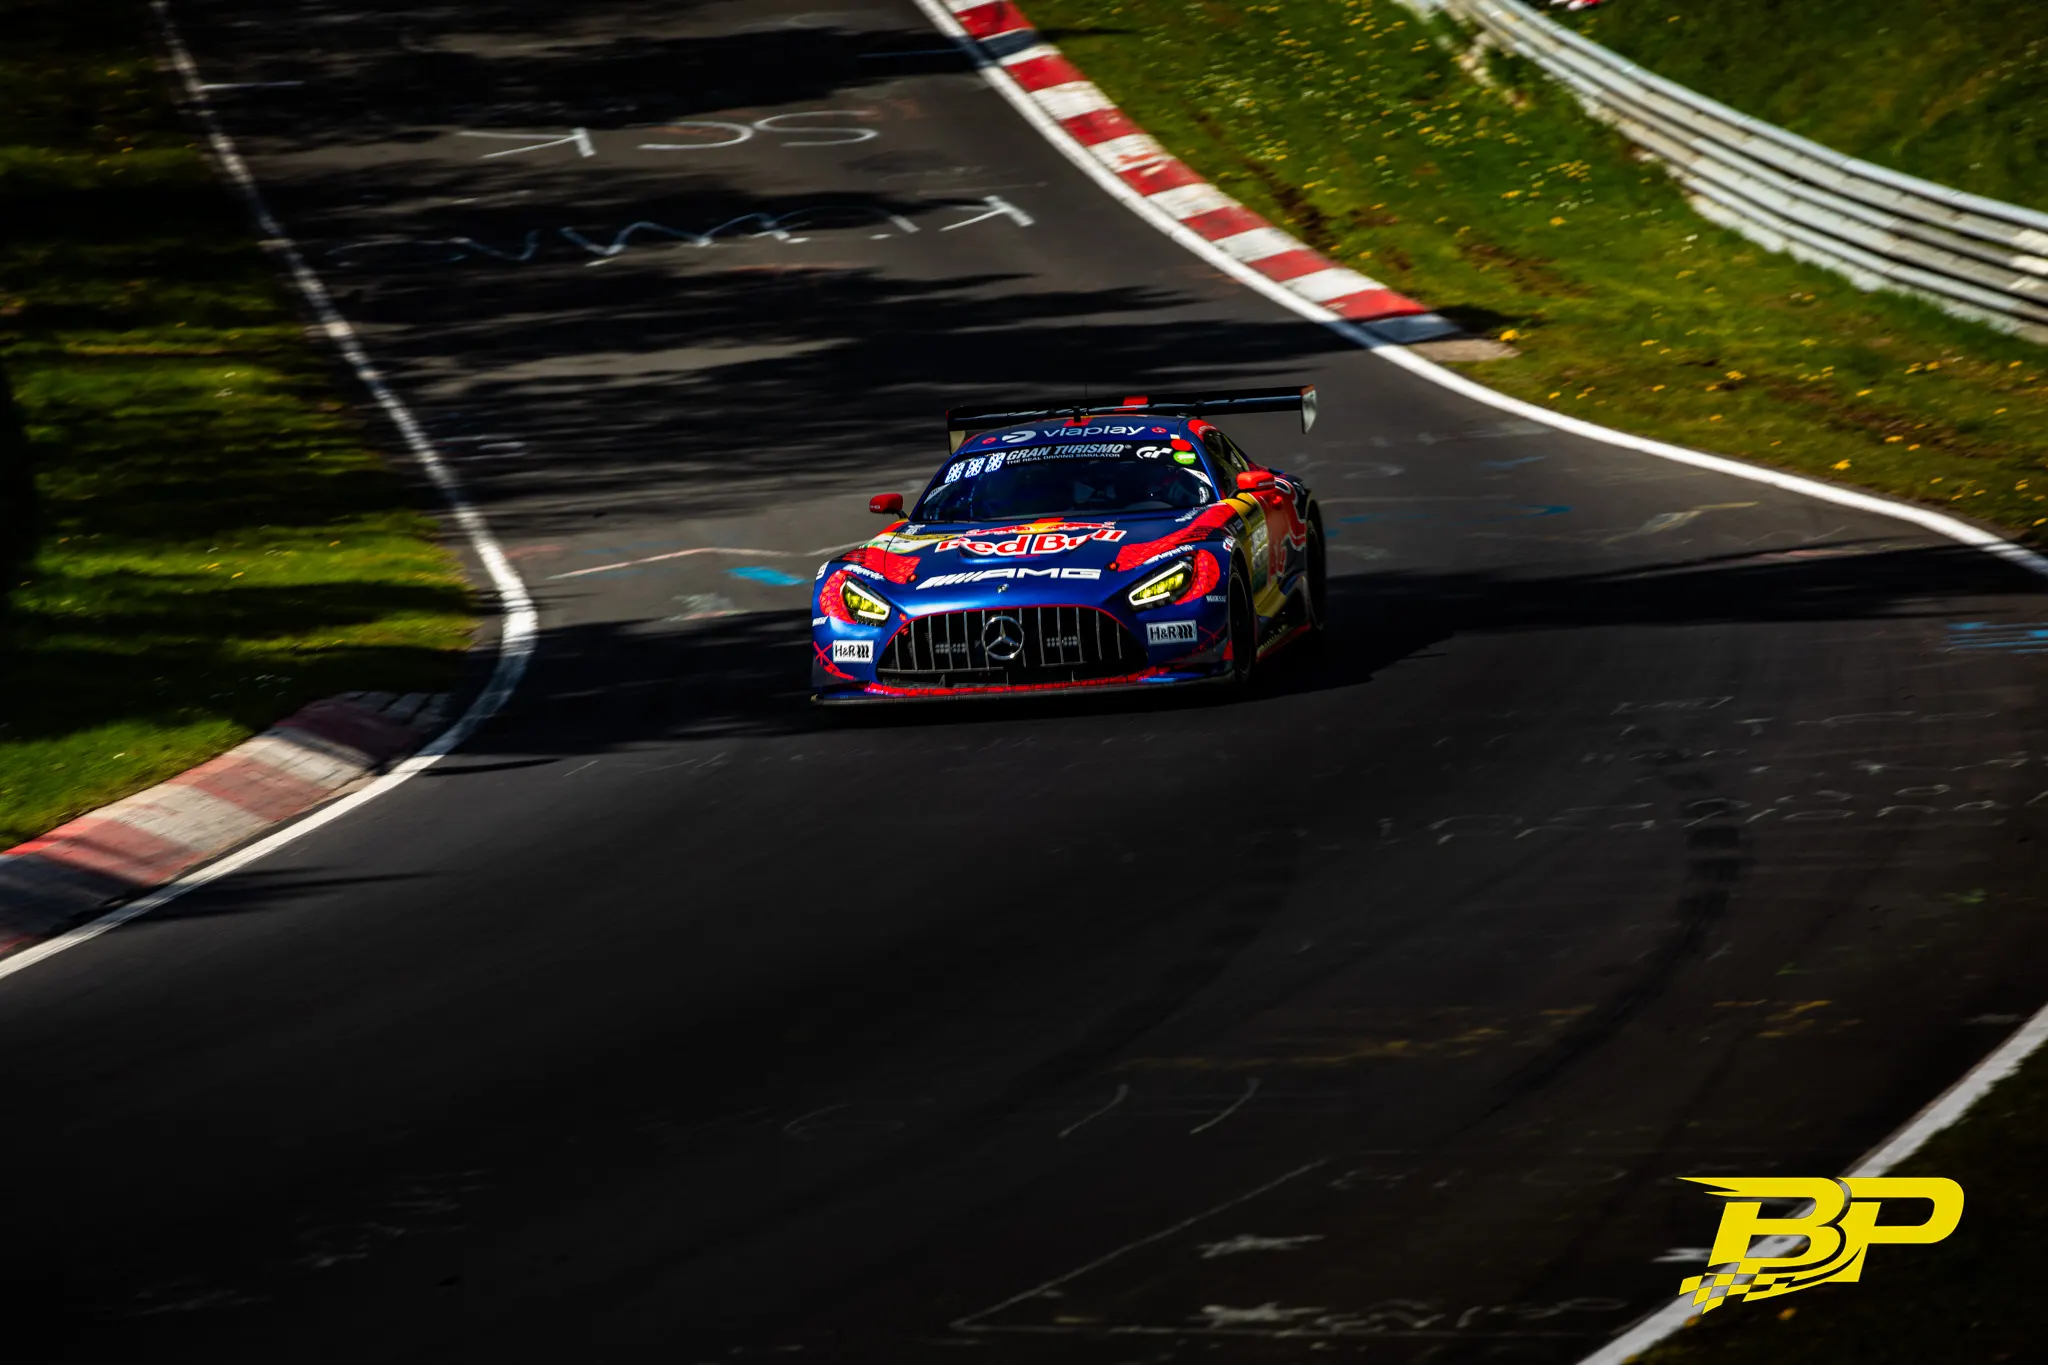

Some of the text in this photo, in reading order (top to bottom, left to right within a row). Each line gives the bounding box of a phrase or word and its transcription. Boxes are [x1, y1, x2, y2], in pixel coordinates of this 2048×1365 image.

[1043, 425, 1146, 437] viaplay
[1006, 446, 1052, 461] GRAN
[934, 529, 1127, 556] Red Bull
[970, 567, 1101, 580] AMG
[1149, 624, 1177, 640] H&R
